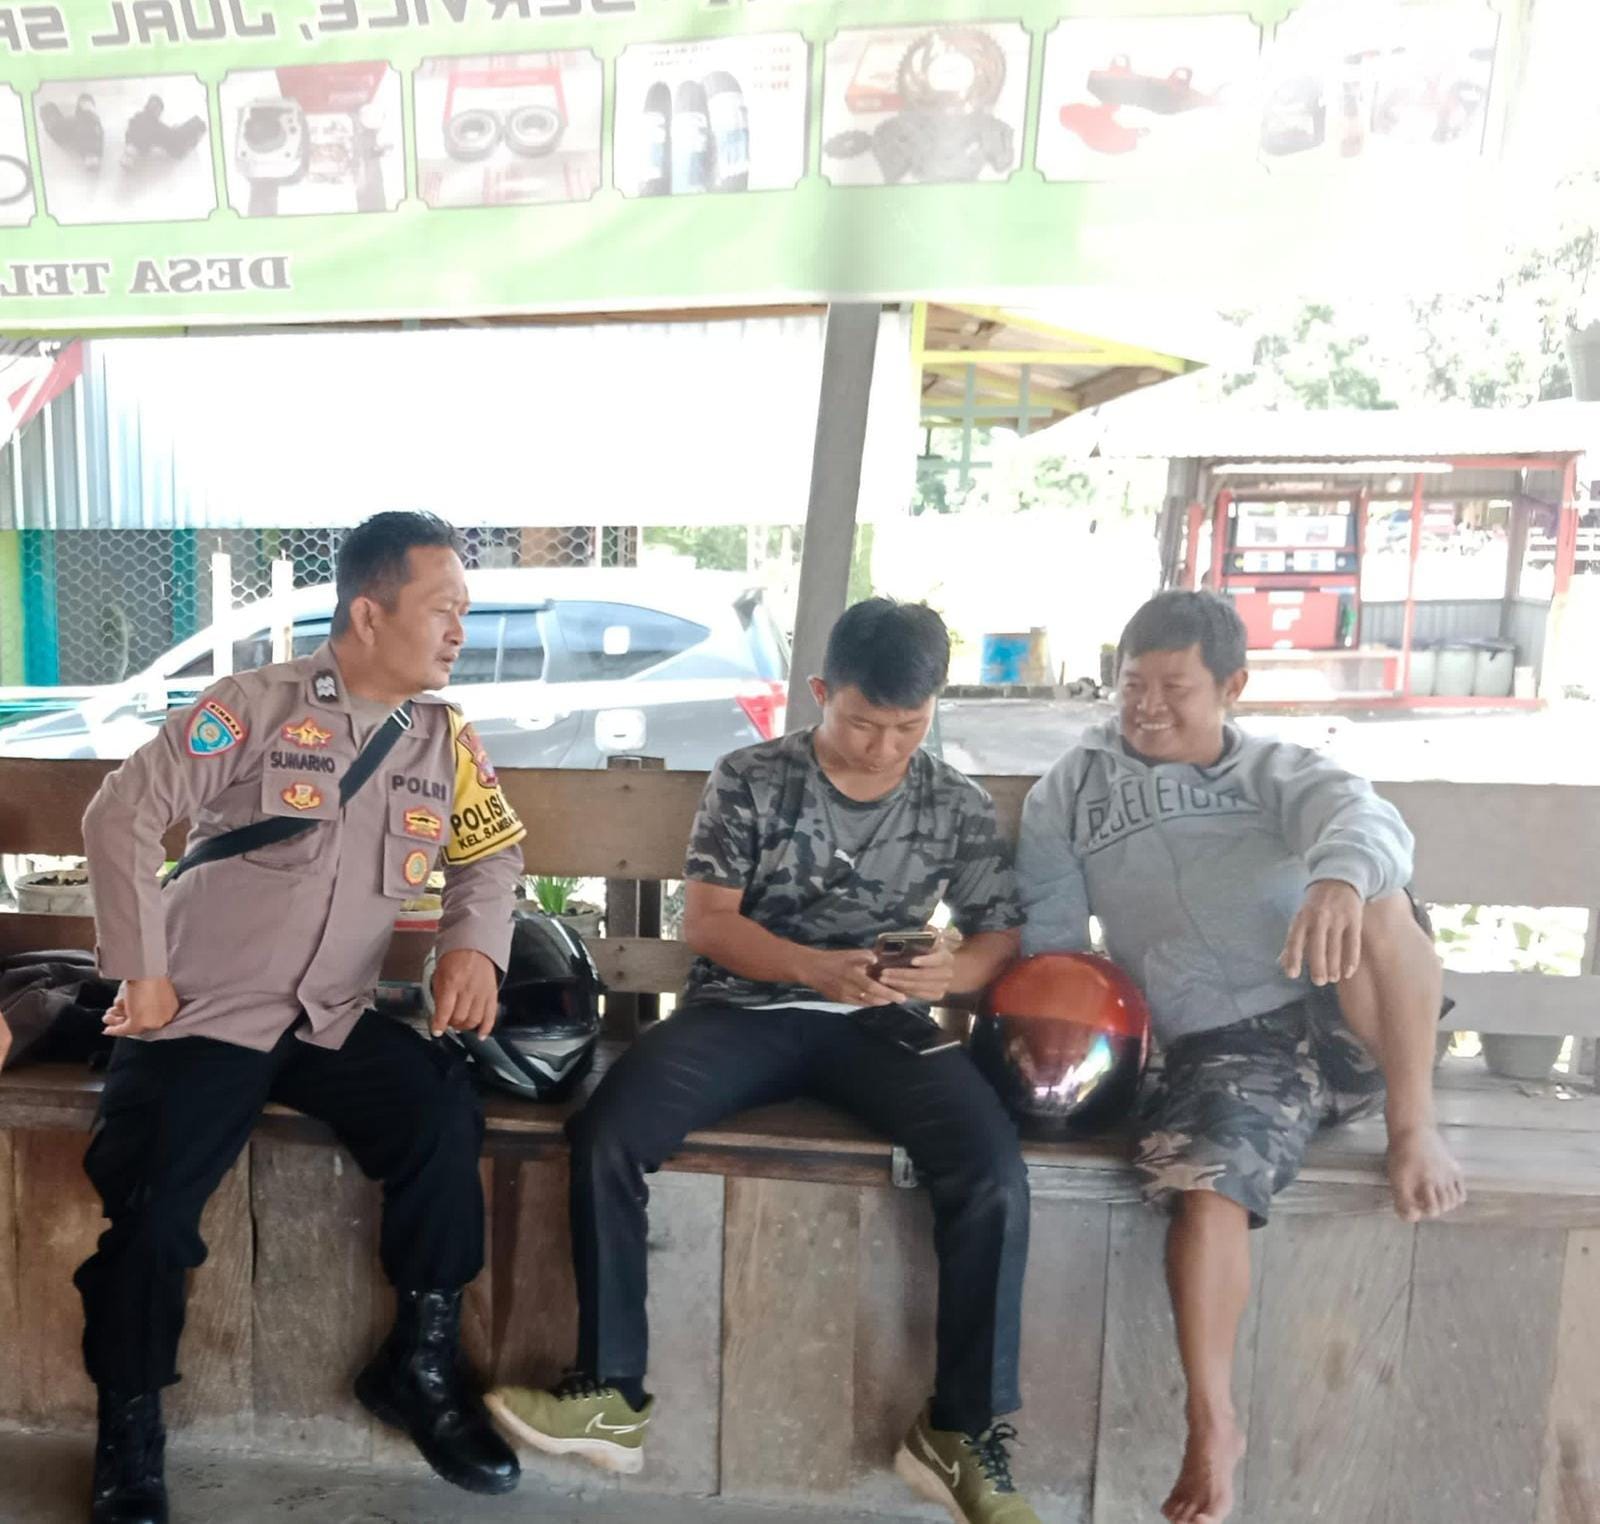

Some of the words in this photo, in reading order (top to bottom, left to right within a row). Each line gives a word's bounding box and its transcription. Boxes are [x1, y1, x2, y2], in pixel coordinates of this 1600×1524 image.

[270, 750, 336, 774] SUMARNO
[391, 774, 448, 802] POLRI
[449, 793, 507, 836] POLISI
